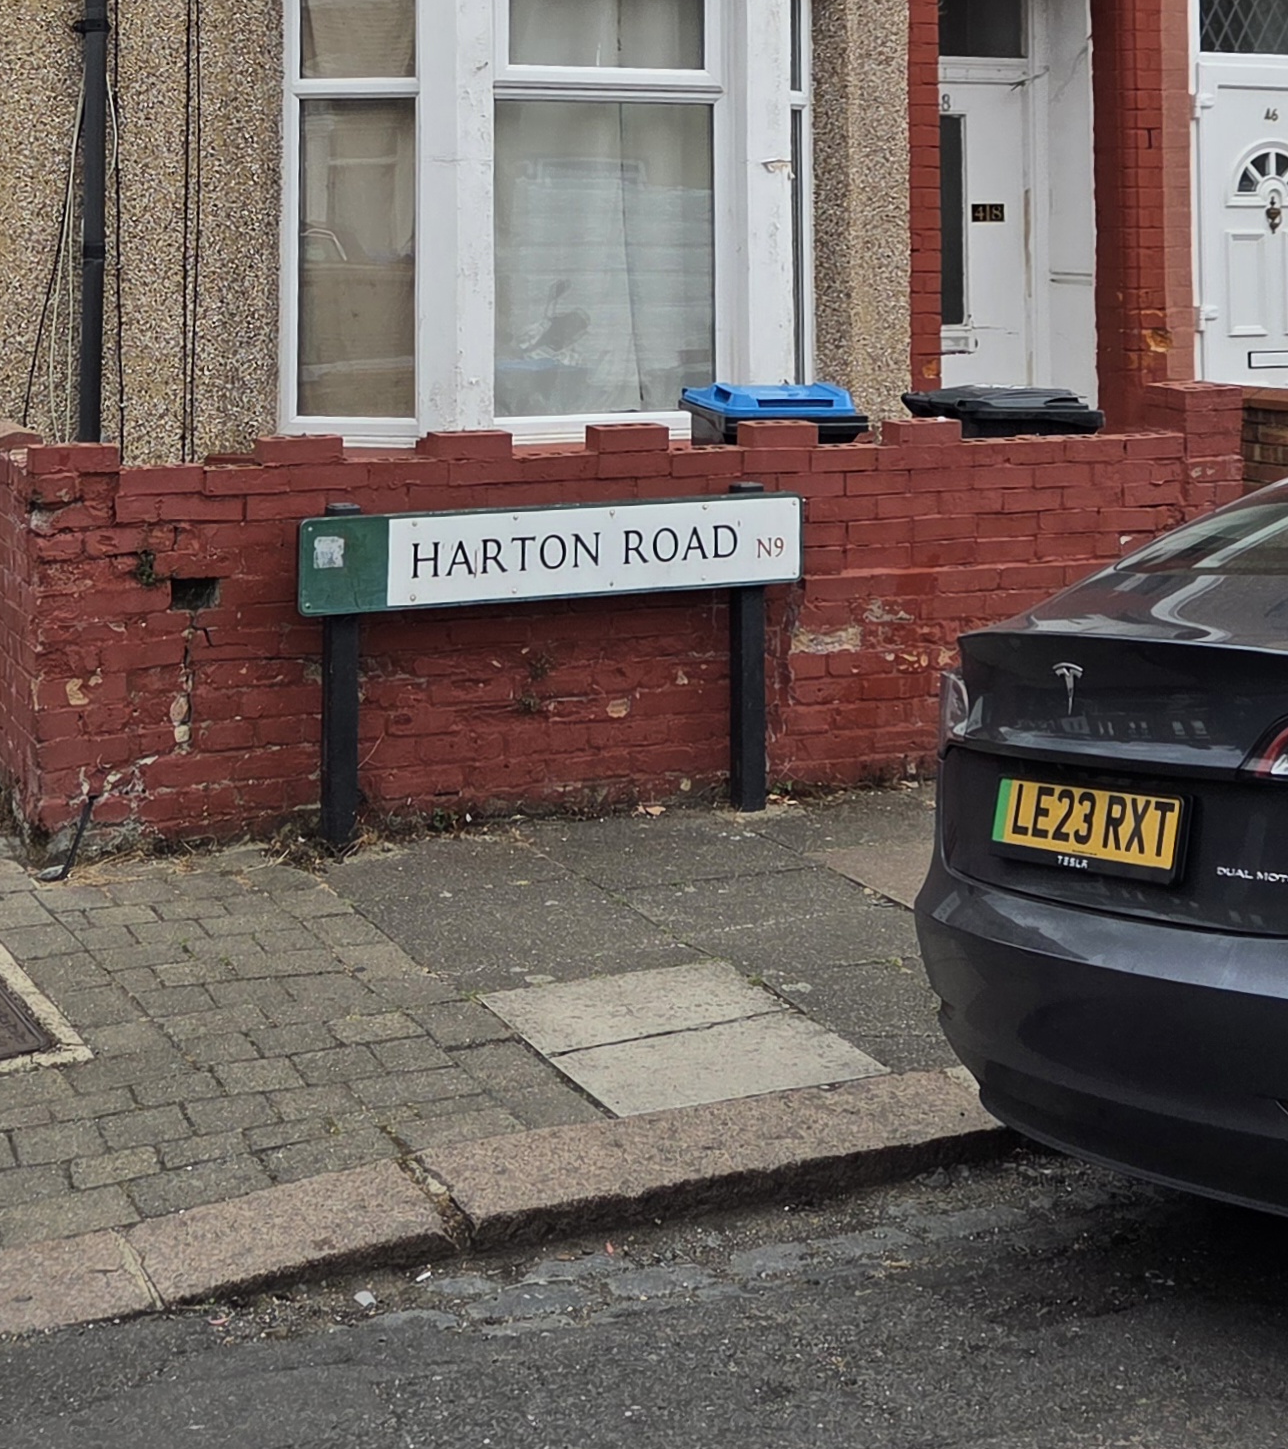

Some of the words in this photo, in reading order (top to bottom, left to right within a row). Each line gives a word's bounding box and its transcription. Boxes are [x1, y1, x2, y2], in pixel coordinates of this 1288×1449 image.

[973, 205, 1002, 221] 48
[410, 531, 602, 580] HARTON
[622, 524, 739, 565] ROAD
[756, 537, 785, 559] N9
[1011, 783, 1097, 845] LE23
[1101, 794, 1176, 857] RXT
[1057, 855, 1089, 869] TESLA
[1216, 866, 1254, 880] DUAL
